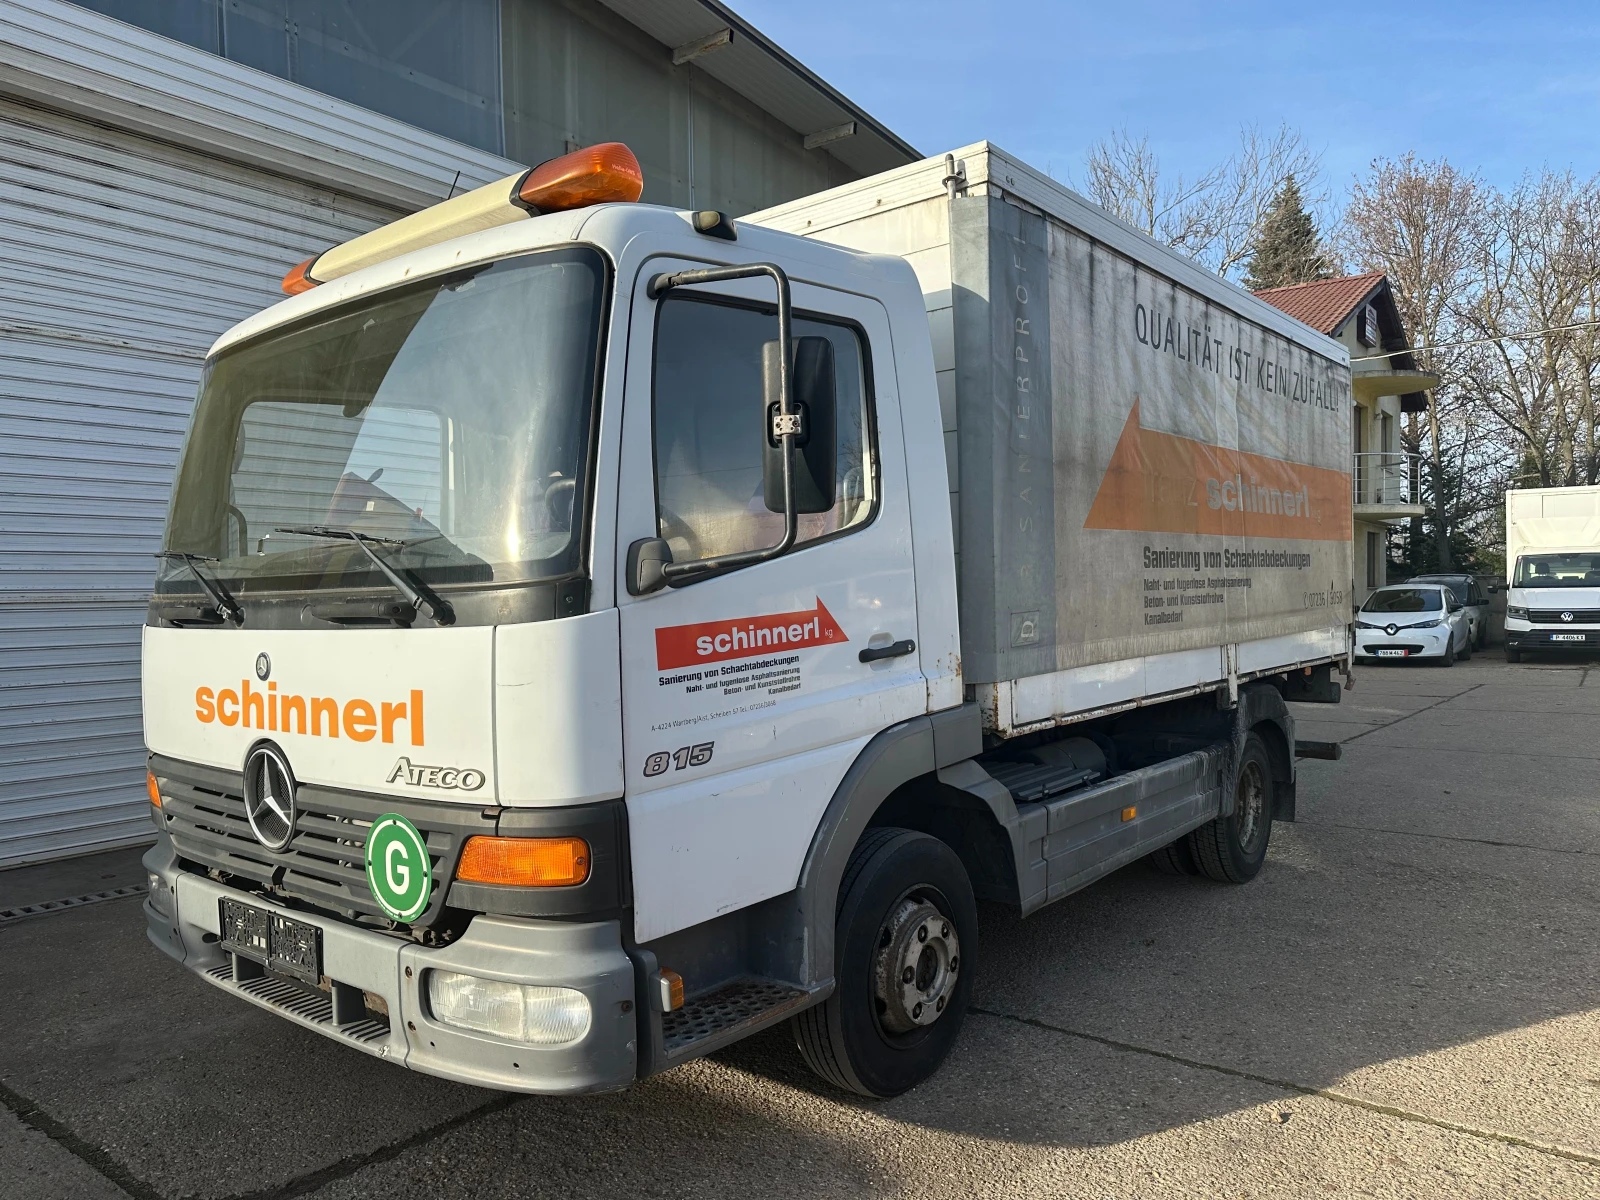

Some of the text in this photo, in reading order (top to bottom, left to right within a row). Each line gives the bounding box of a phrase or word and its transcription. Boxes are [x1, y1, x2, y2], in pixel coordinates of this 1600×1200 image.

[1135, 303, 1339, 413] QUALITÄT IST KEIN ZUFALL!
[1206, 473, 1310, 518] schinnerl
[1143, 546, 1311, 571] Sanierung von Schachtabdeckungen
[1144, 577, 1252, 591] Naht- und fugenlose Asphaltsanierung
[1144, 593, 1224, 608] Beton- und Kunststoffrohre
[1144, 610, 1183, 626] Kanalbedarf
[696, 616, 833, 656] schinnerl kg
[659, 655, 800, 686] Sanierung von Schachtabdeckungen
[686, 667, 800, 694] Naht- und fugenlose Asphaltsanierung
[723, 675, 801, 696] Beton- und Kunststoffrohre
[768, 683, 802, 695] Kanalbedarf
[195, 679, 425, 747] schinnerl
[642, 741, 715, 778] 815
[385, 840, 410, 896] G
